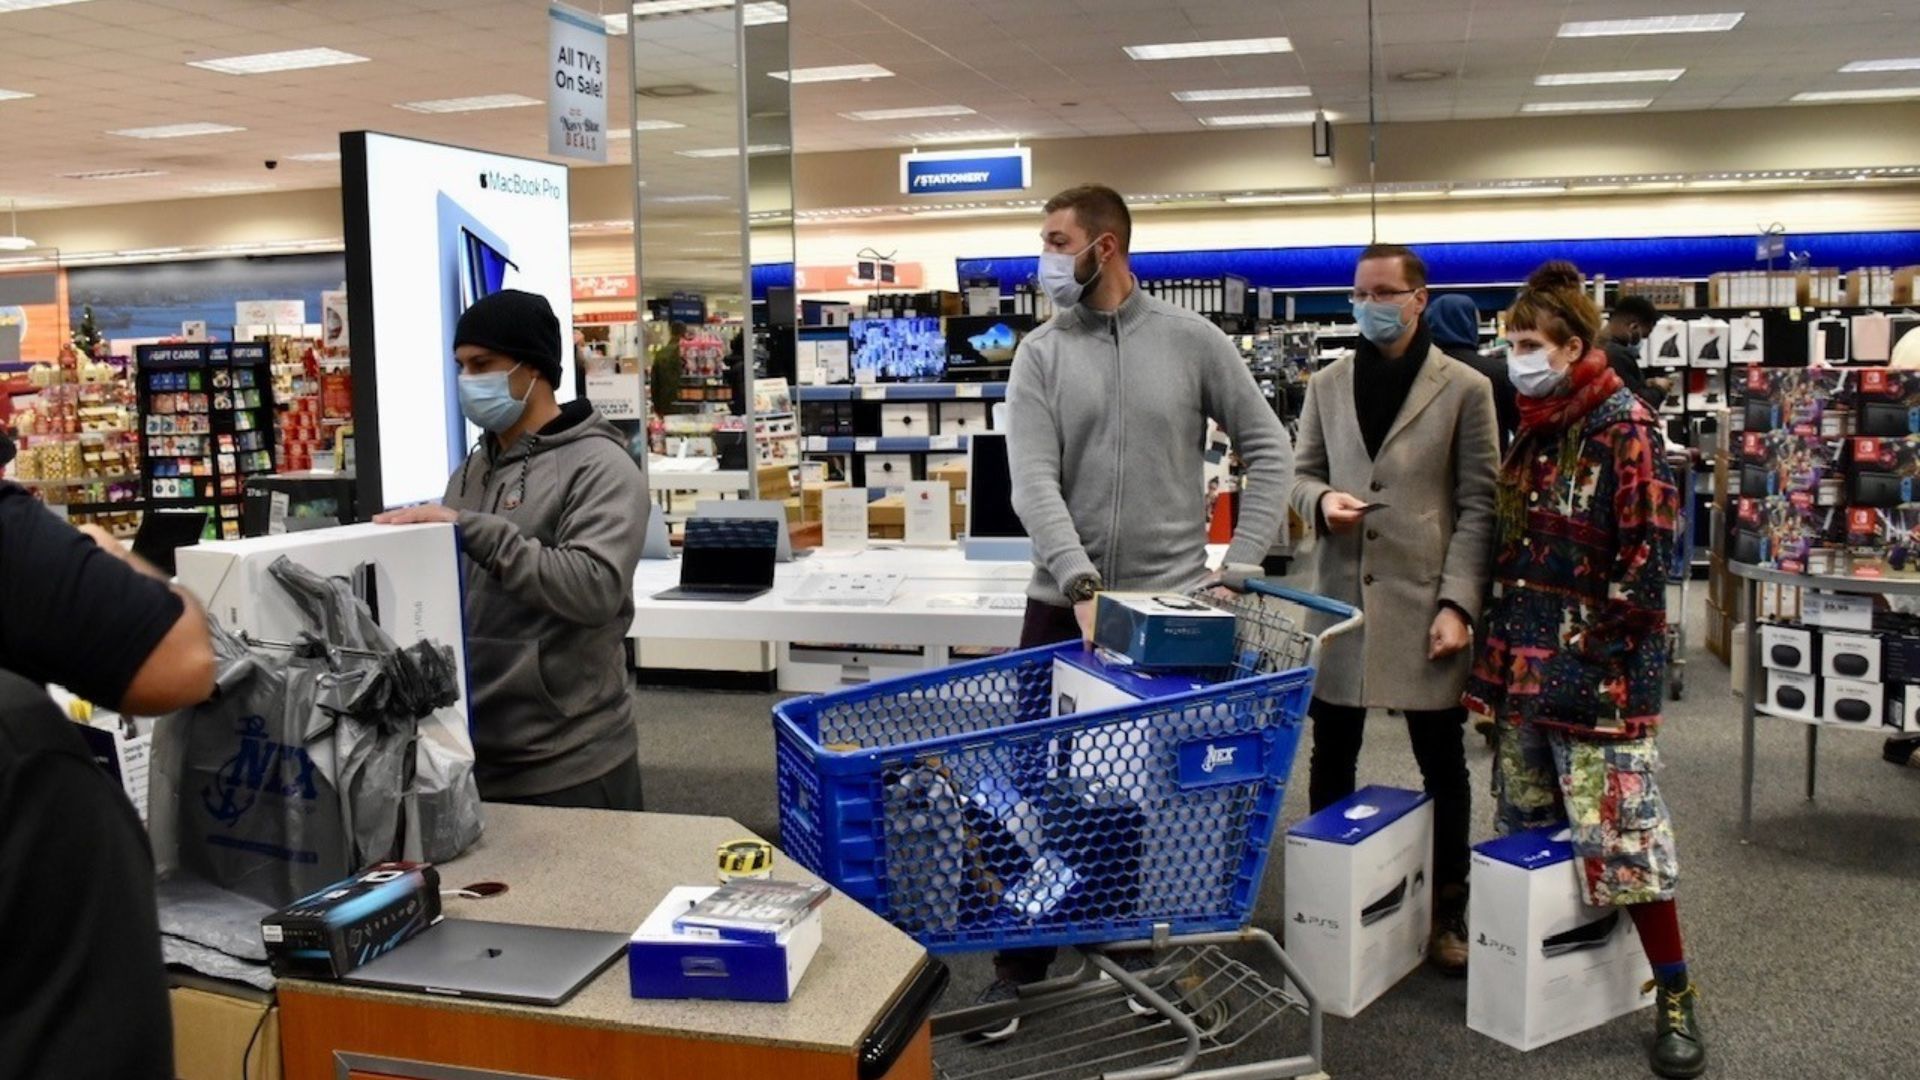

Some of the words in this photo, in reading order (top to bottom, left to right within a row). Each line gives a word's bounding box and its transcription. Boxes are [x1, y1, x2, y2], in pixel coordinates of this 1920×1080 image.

[558, 46, 573, 66] All
[577, 51, 600, 74] TV's
[556, 70, 573, 90] On
[578, 76, 603, 98] Sale!
[560, 116, 582, 132] Navy
[565, 132, 596, 151] DEALS
[489, 170, 540, 196] MacBook
[543, 178, 560, 199] Pro
[172, 349, 199, 361] CARDS
[1209, 746, 1238, 763] NEX
[1308, 916, 1339, 930] PS5
[1488, 939, 1517, 957] PS5
